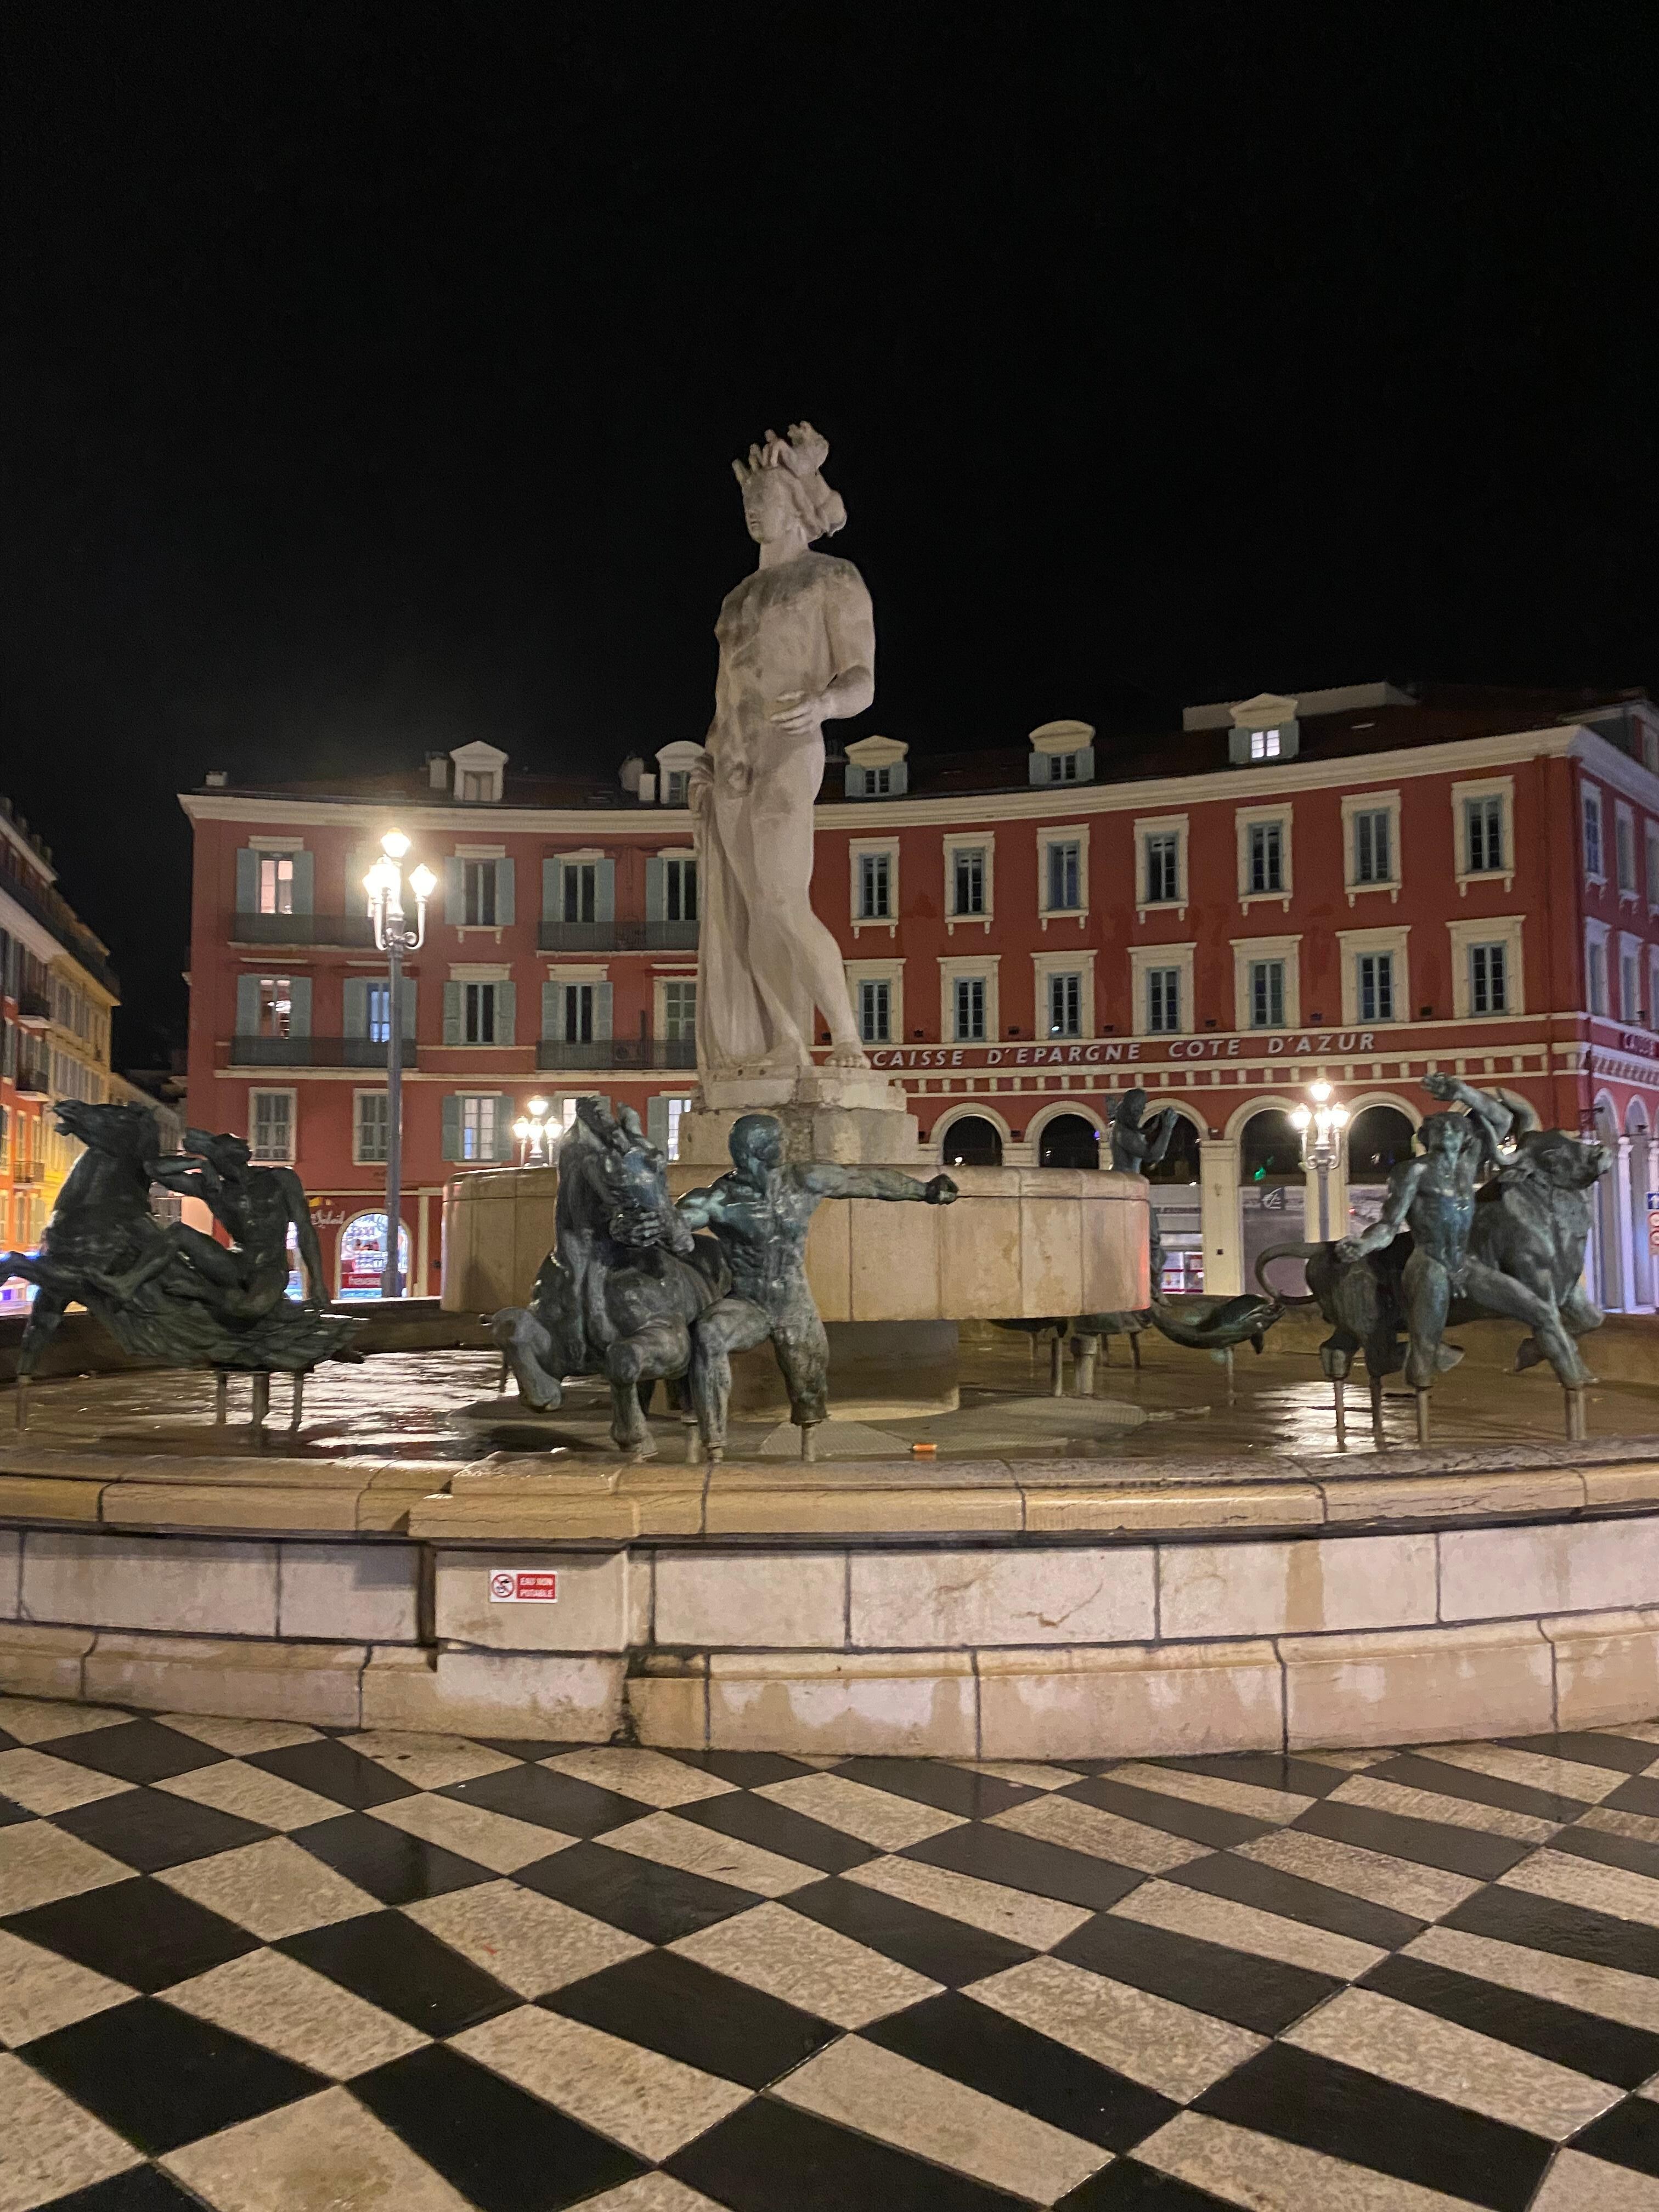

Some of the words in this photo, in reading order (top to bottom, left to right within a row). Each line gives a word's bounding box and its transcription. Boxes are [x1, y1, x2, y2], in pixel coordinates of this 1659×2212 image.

[872, 1050, 963, 1066] CAISSE
[988, 1043, 1141, 1064] D'EPARGNE
[1169, 1039, 1241, 1057] COTE
[1268, 1033, 1375, 1054] D'AZUR
